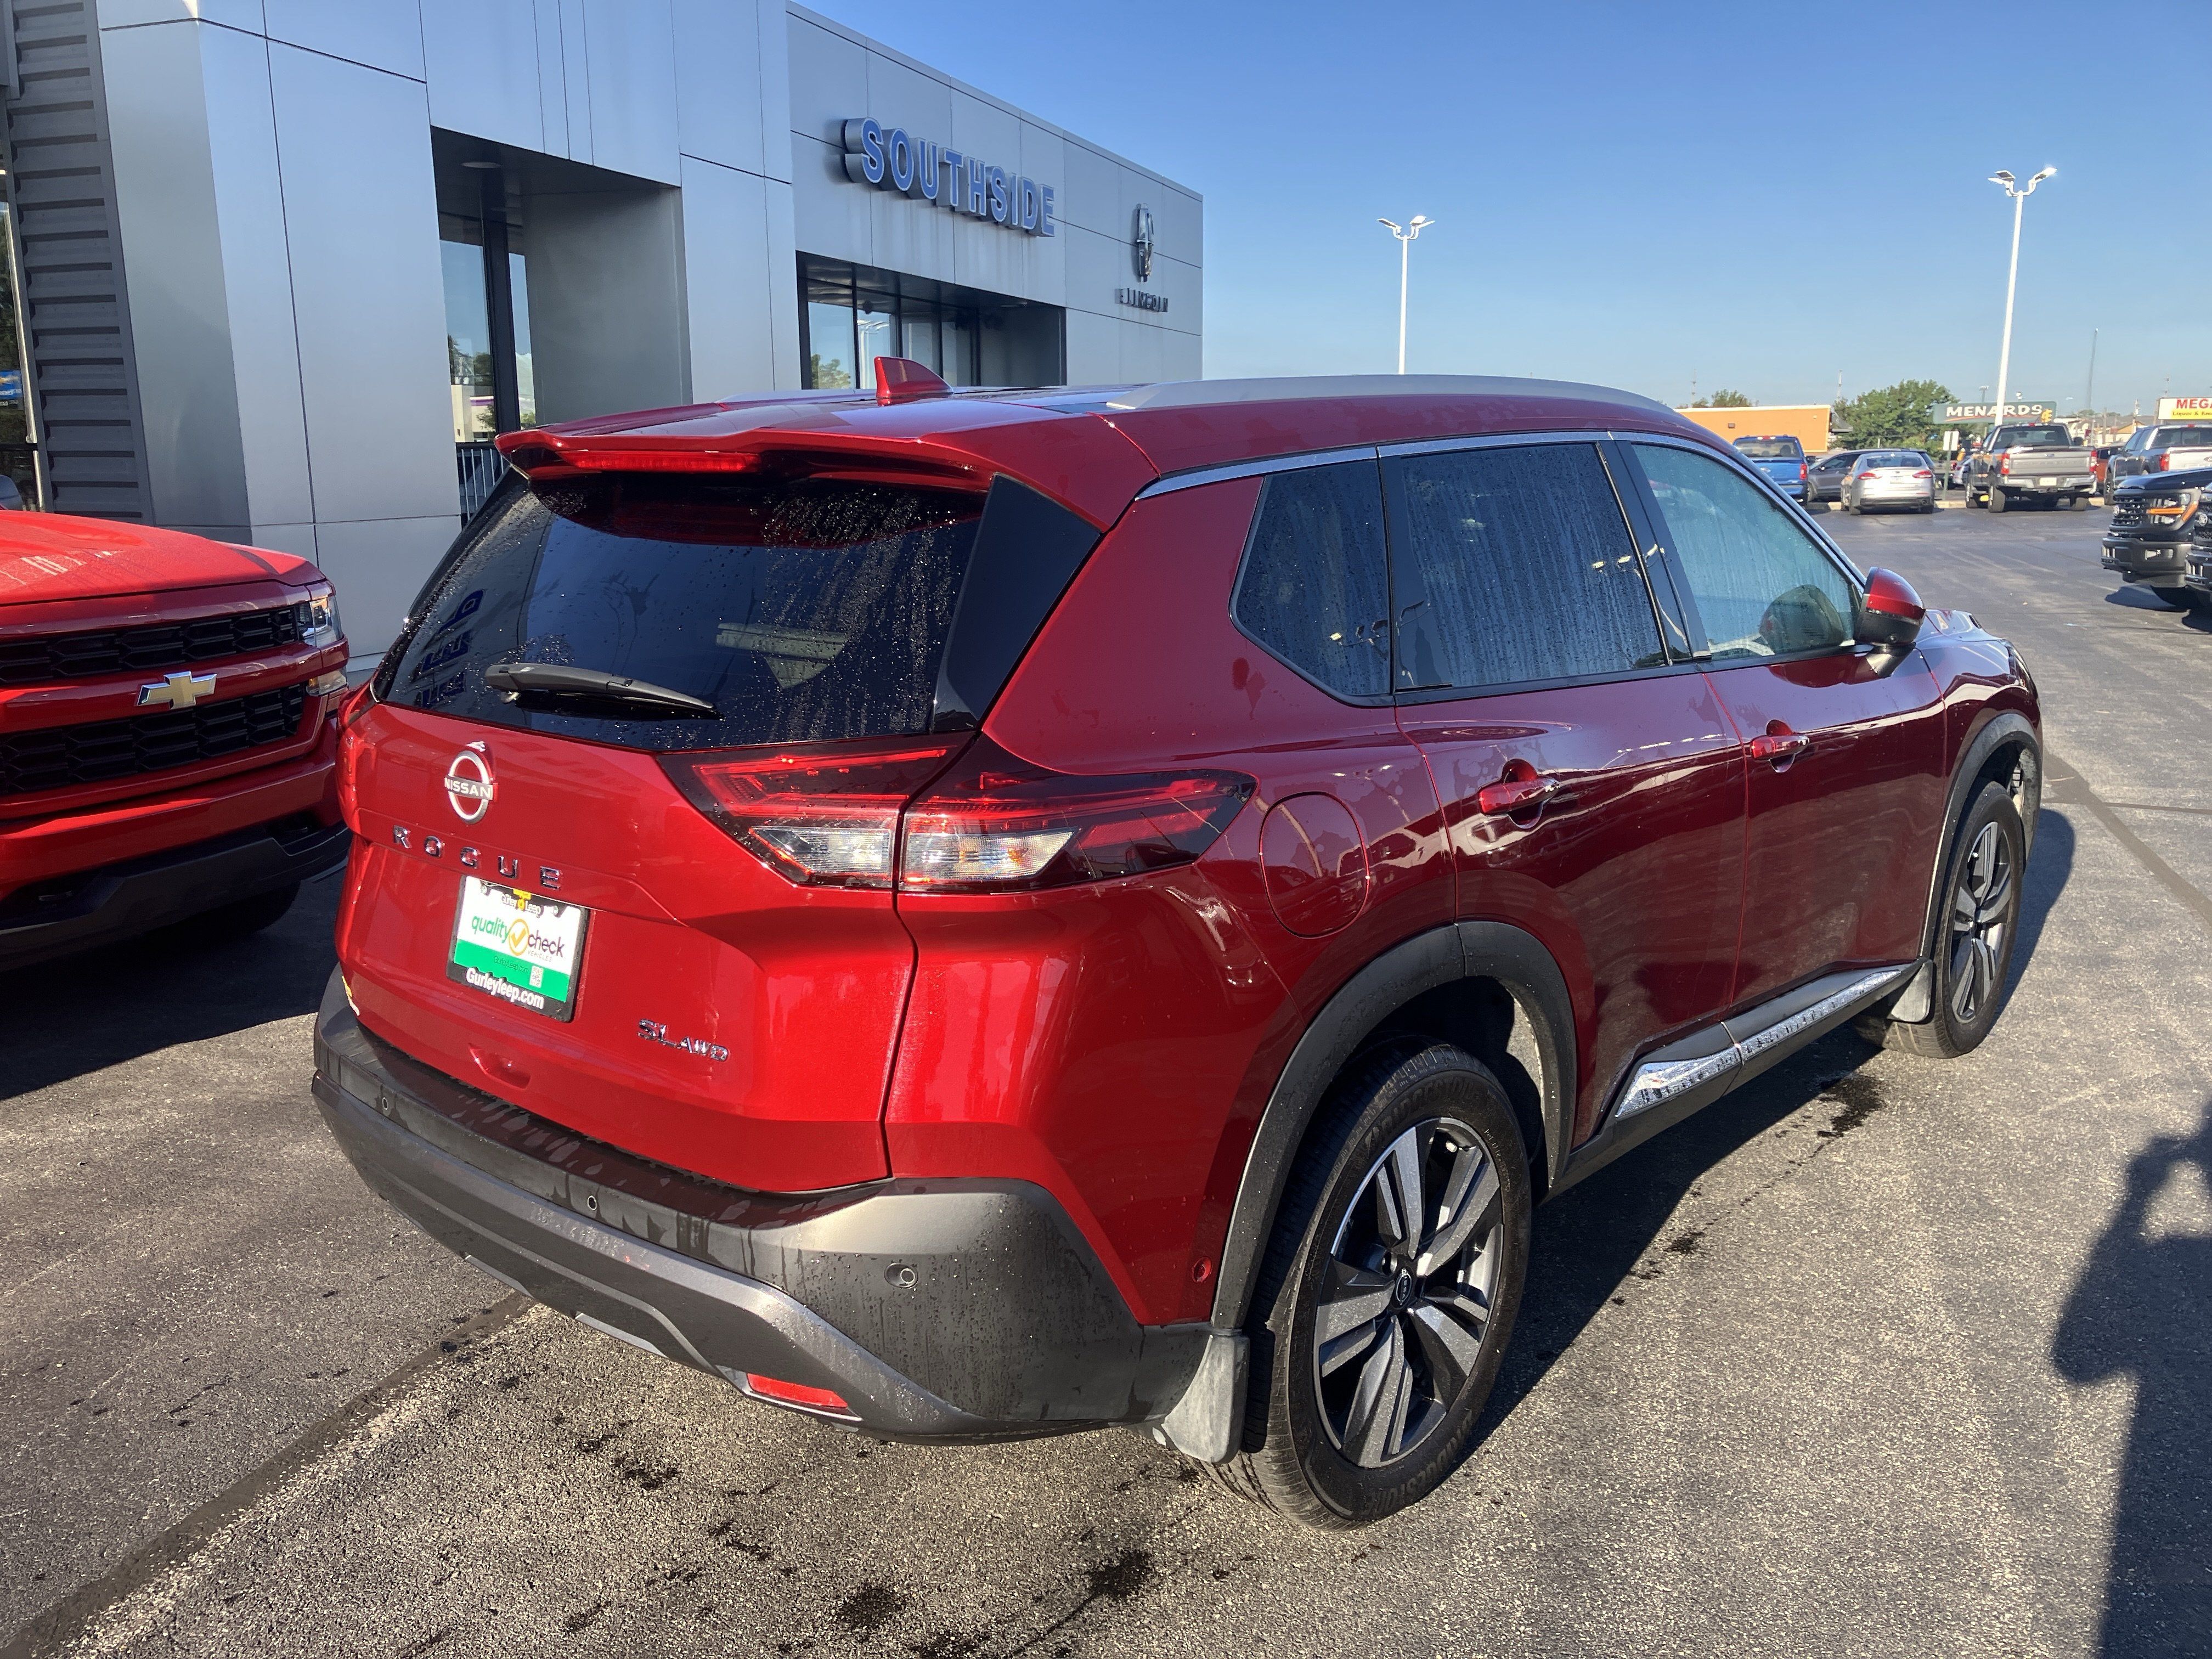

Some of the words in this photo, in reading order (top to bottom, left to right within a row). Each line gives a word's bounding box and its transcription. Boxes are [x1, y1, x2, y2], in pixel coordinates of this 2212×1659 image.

[846, 117, 1055, 237] SOUTHSIDE
[2176, 398, 2212, 409] MEG
[444, 777, 493, 799] NISSAN
[393, 825, 561, 890] ROGUE
[471, 915, 511, 943] quality
[527, 930, 566, 957] check
[527, 949, 552, 962] VEHICLES
